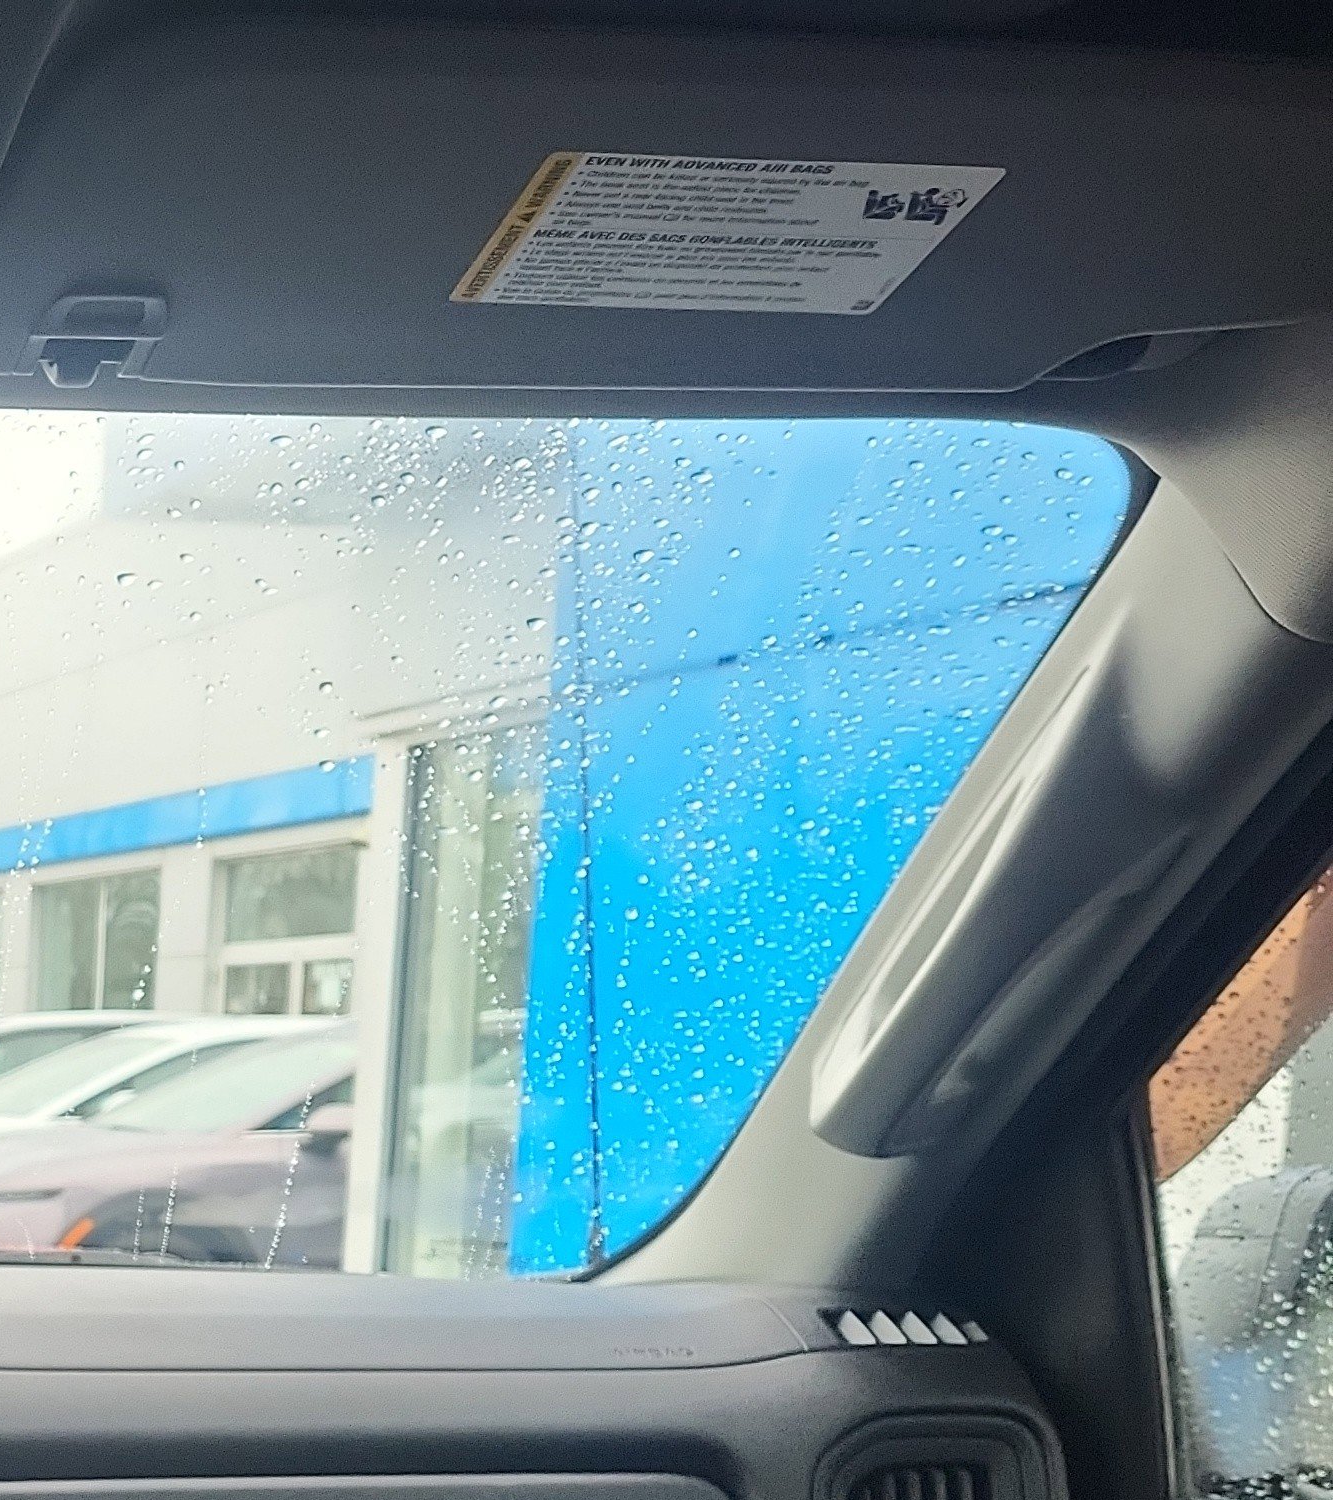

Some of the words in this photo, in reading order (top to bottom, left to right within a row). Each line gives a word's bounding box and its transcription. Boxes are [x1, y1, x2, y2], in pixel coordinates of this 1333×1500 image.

[585, 156, 627, 167] EVEN
[629, 157, 671, 168] WITH
[672, 159, 758, 172] ADVANCED
[759, 163, 790, 173] AIR
[790, 164, 834, 174] BAGS
[578, 231, 616, 241] AVEC
[617, 232, 648, 242] DES
[648, 233, 688, 243] SACS
